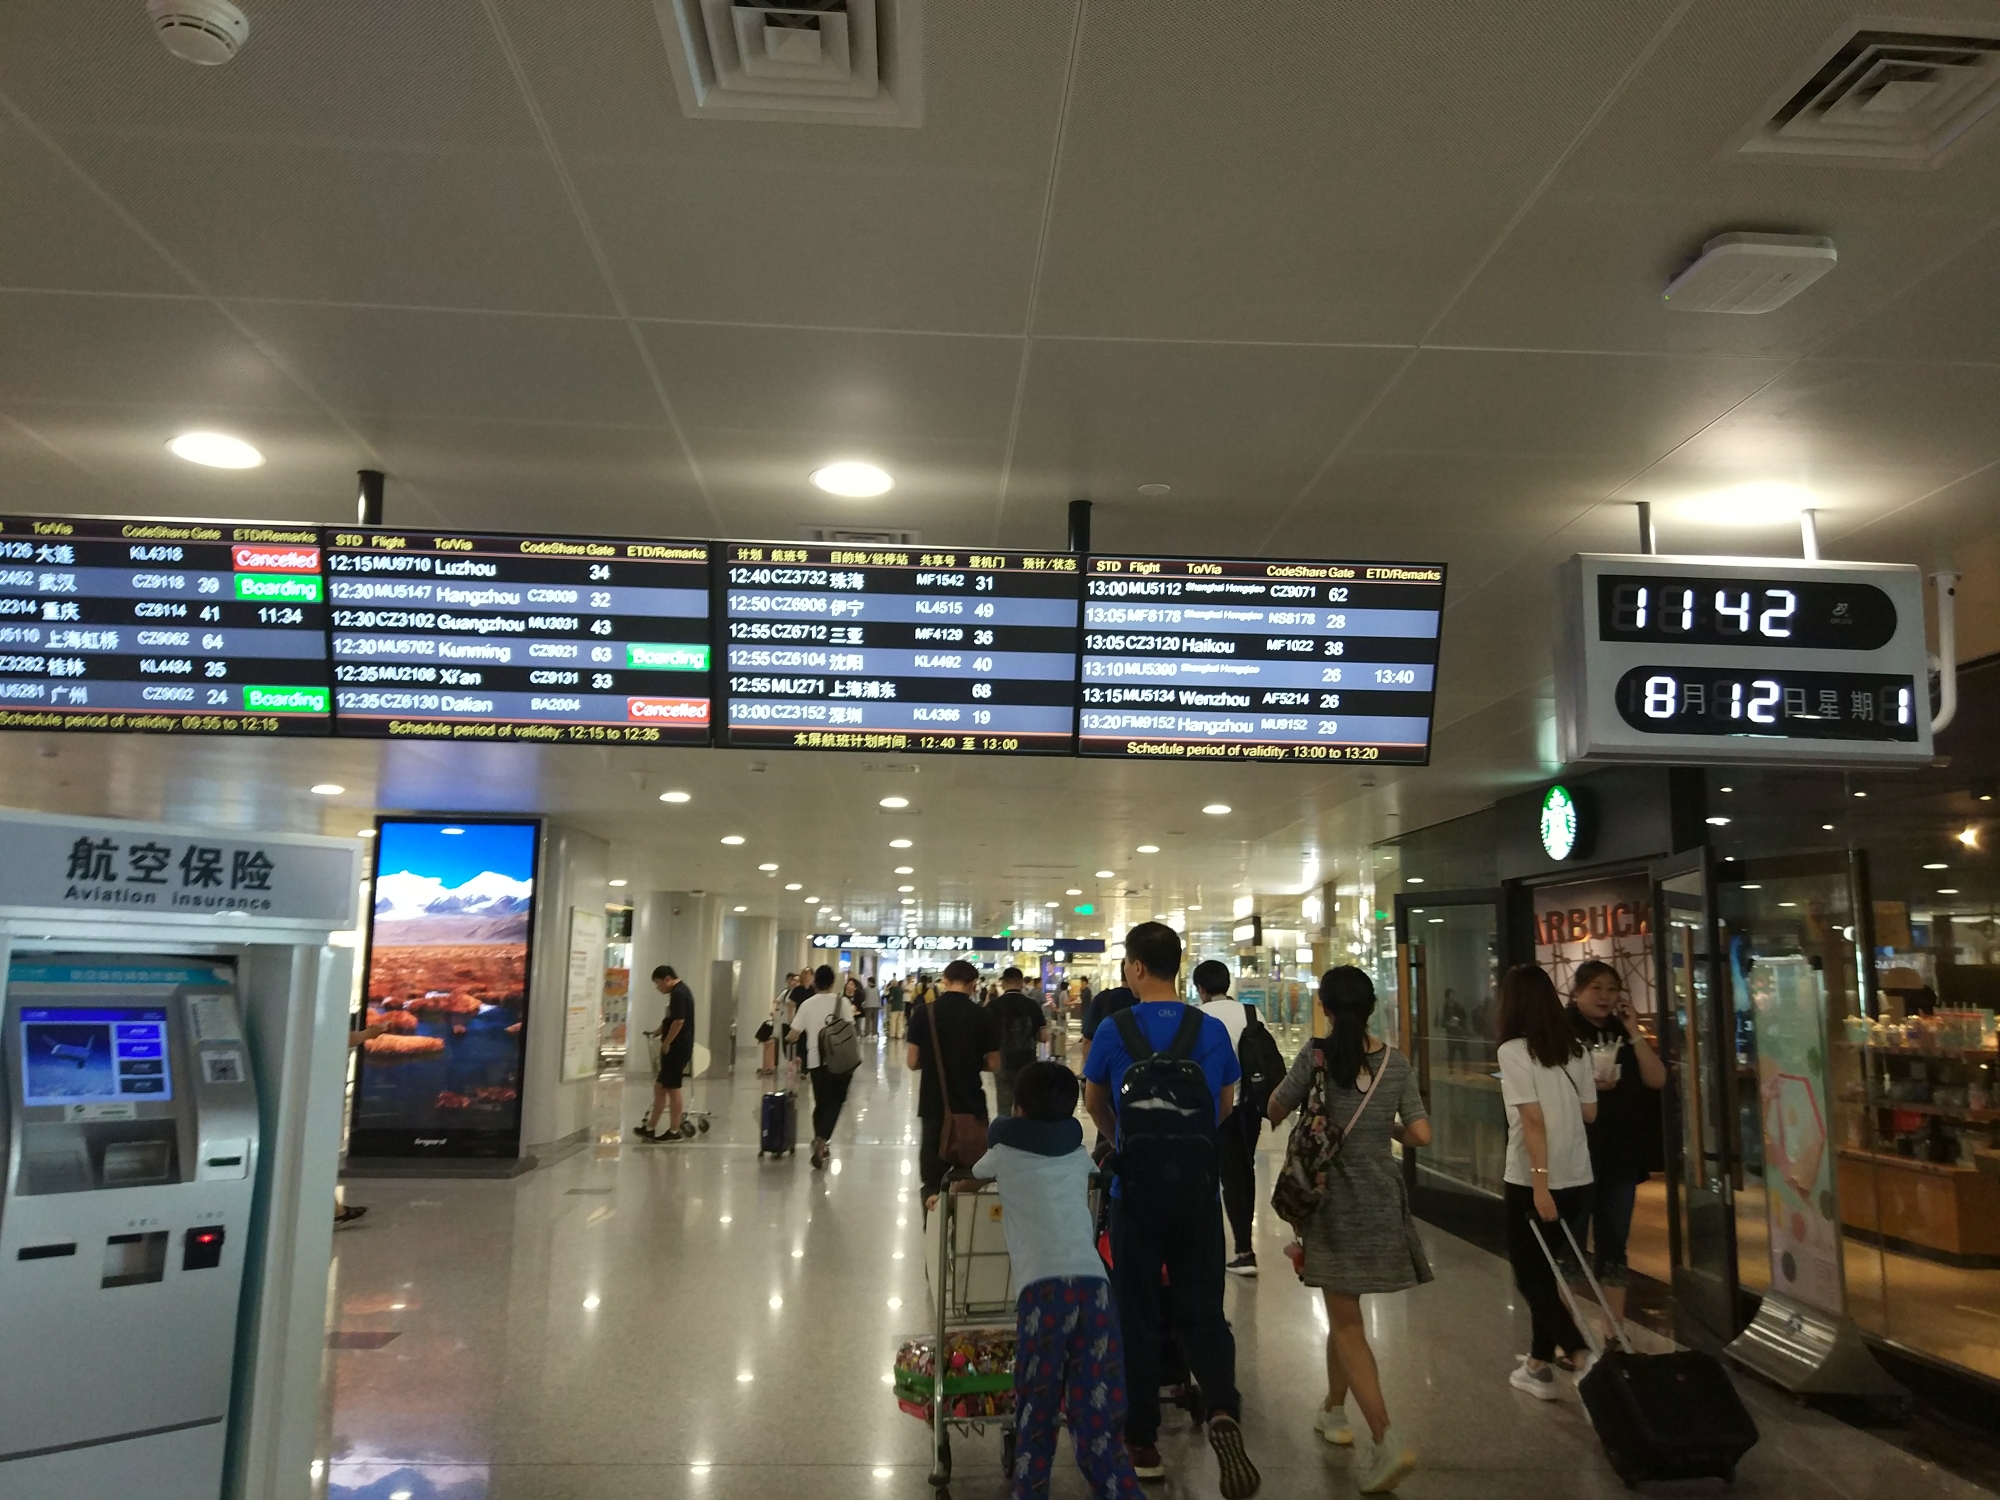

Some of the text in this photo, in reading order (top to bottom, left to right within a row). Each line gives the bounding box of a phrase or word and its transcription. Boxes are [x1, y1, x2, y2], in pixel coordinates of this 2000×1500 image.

[190, 526, 222, 540] Gate
[35, 544, 318, 568] 大连 Cancelled
[335, 534, 707, 560] STD Flight To/Via CodeShare Gate ETD/Remarks
[328, 555, 372, 572] 12:15
[434, 558, 496, 577] Luzhou
[589, 564, 610, 580] 34
[737, 548, 763, 562] 计划
[770, 549, 808, 562] 航班号
[920, 554, 956, 568] 共享号
[969, 556, 1006, 568] 登机门
[1022, 558, 1077, 571] 预计/状态
[1096, 560, 1441, 580] STD Flight To/Via CodeShare Gate ETD/Remarks
[38, 572, 316, 600] 武汉 39 Boarding
[728, 568, 994, 591] 12:40 CZ3732 珠海 MF1542 31
[330, 582, 611, 608] 12:30 MU5147 Hangzhou 32
[1088, 580, 1128, 596] 13:00
[1128, 582, 1182, 596] MU5112
[1328, 588, 1348, 602] 62
[41, 602, 81, 620] 重庆
[200, 605, 220, 621] 41
[728, 596, 994, 618] 12:50 伊宁 KL4515 49
[332, 610, 612, 635] 12:30 CZ3102 Guangzhou 43
[1086, 608, 1127, 624] 13:05
[1326, 614, 1346, 629] 28
[44, 630, 224, 650] 上海虹桥 64
[729, 622, 771, 639] 12:55
[771, 624, 828, 640] CZ6712
[828, 627, 864, 644] 三亚
[974, 630, 994, 646] 36
[1085, 634, 1344, 656] 13:05 CZ3120 Haikou MF1022 38
[333, 638, 376, 654] 12:30
[438, 642, 511, 662] Kunming
[591, 646, 612, 662] 63
[632, 649, 705, 669] Boarding
[730, 650, 992, 672] 12:55 CZ6104 沈阳 40
[46, 657, 227, 678] 桂林 35
[334, 665, 378, 682] 12:35
[592, 674, 613, 689] 33
[1084, 662, 1415, 684] 13:10 26 13:40
[50, 685, 324, 710] 广州 24 Boarding
[730, 677, 992, 699] 12:55 MU271 上海浦东 68
[1082, 688, 1340, 708] 13:15 MU5134 Wenzhou AF5214 26
[336, 692, 380, 709] 12:35
[441, 696, 494, 712] Dalian
[632, 702, 707, 718] Cancelled
[730, 704, 991, 725] 13:00 CZ3152 深圳 19
[64, 714, 108, 730] period
[110, 714, 126, 728] of
[222, 716, 238, 730] to
[388, 720, 452, 736] Schedule
[454, 724, 496, 738] period
[498, 724, 512, 737] of
[568, 726, 605, 740] 12:15
[606, 728, 622, 740] to
[623, 728, 660, 742] 12:35
[1082, 714, 1122, 730] 13:20
[1122, 716, 1176, 730] FM9152
[1178, 717, 1254, 736] Hangzhou
[1318, 720, 1338, 735] 29
[920, 736, 956, 749] 12:40
[962, 736, 976, 750] 至
[982, 738, 1018, 750] 13:00
[1126, 742, 1379, 760] Schedule period of validity: 13:00 to 13:20
[66, 836, 276, 891] 航空保险
[64, 884, 273, 910] Aviation insurance
